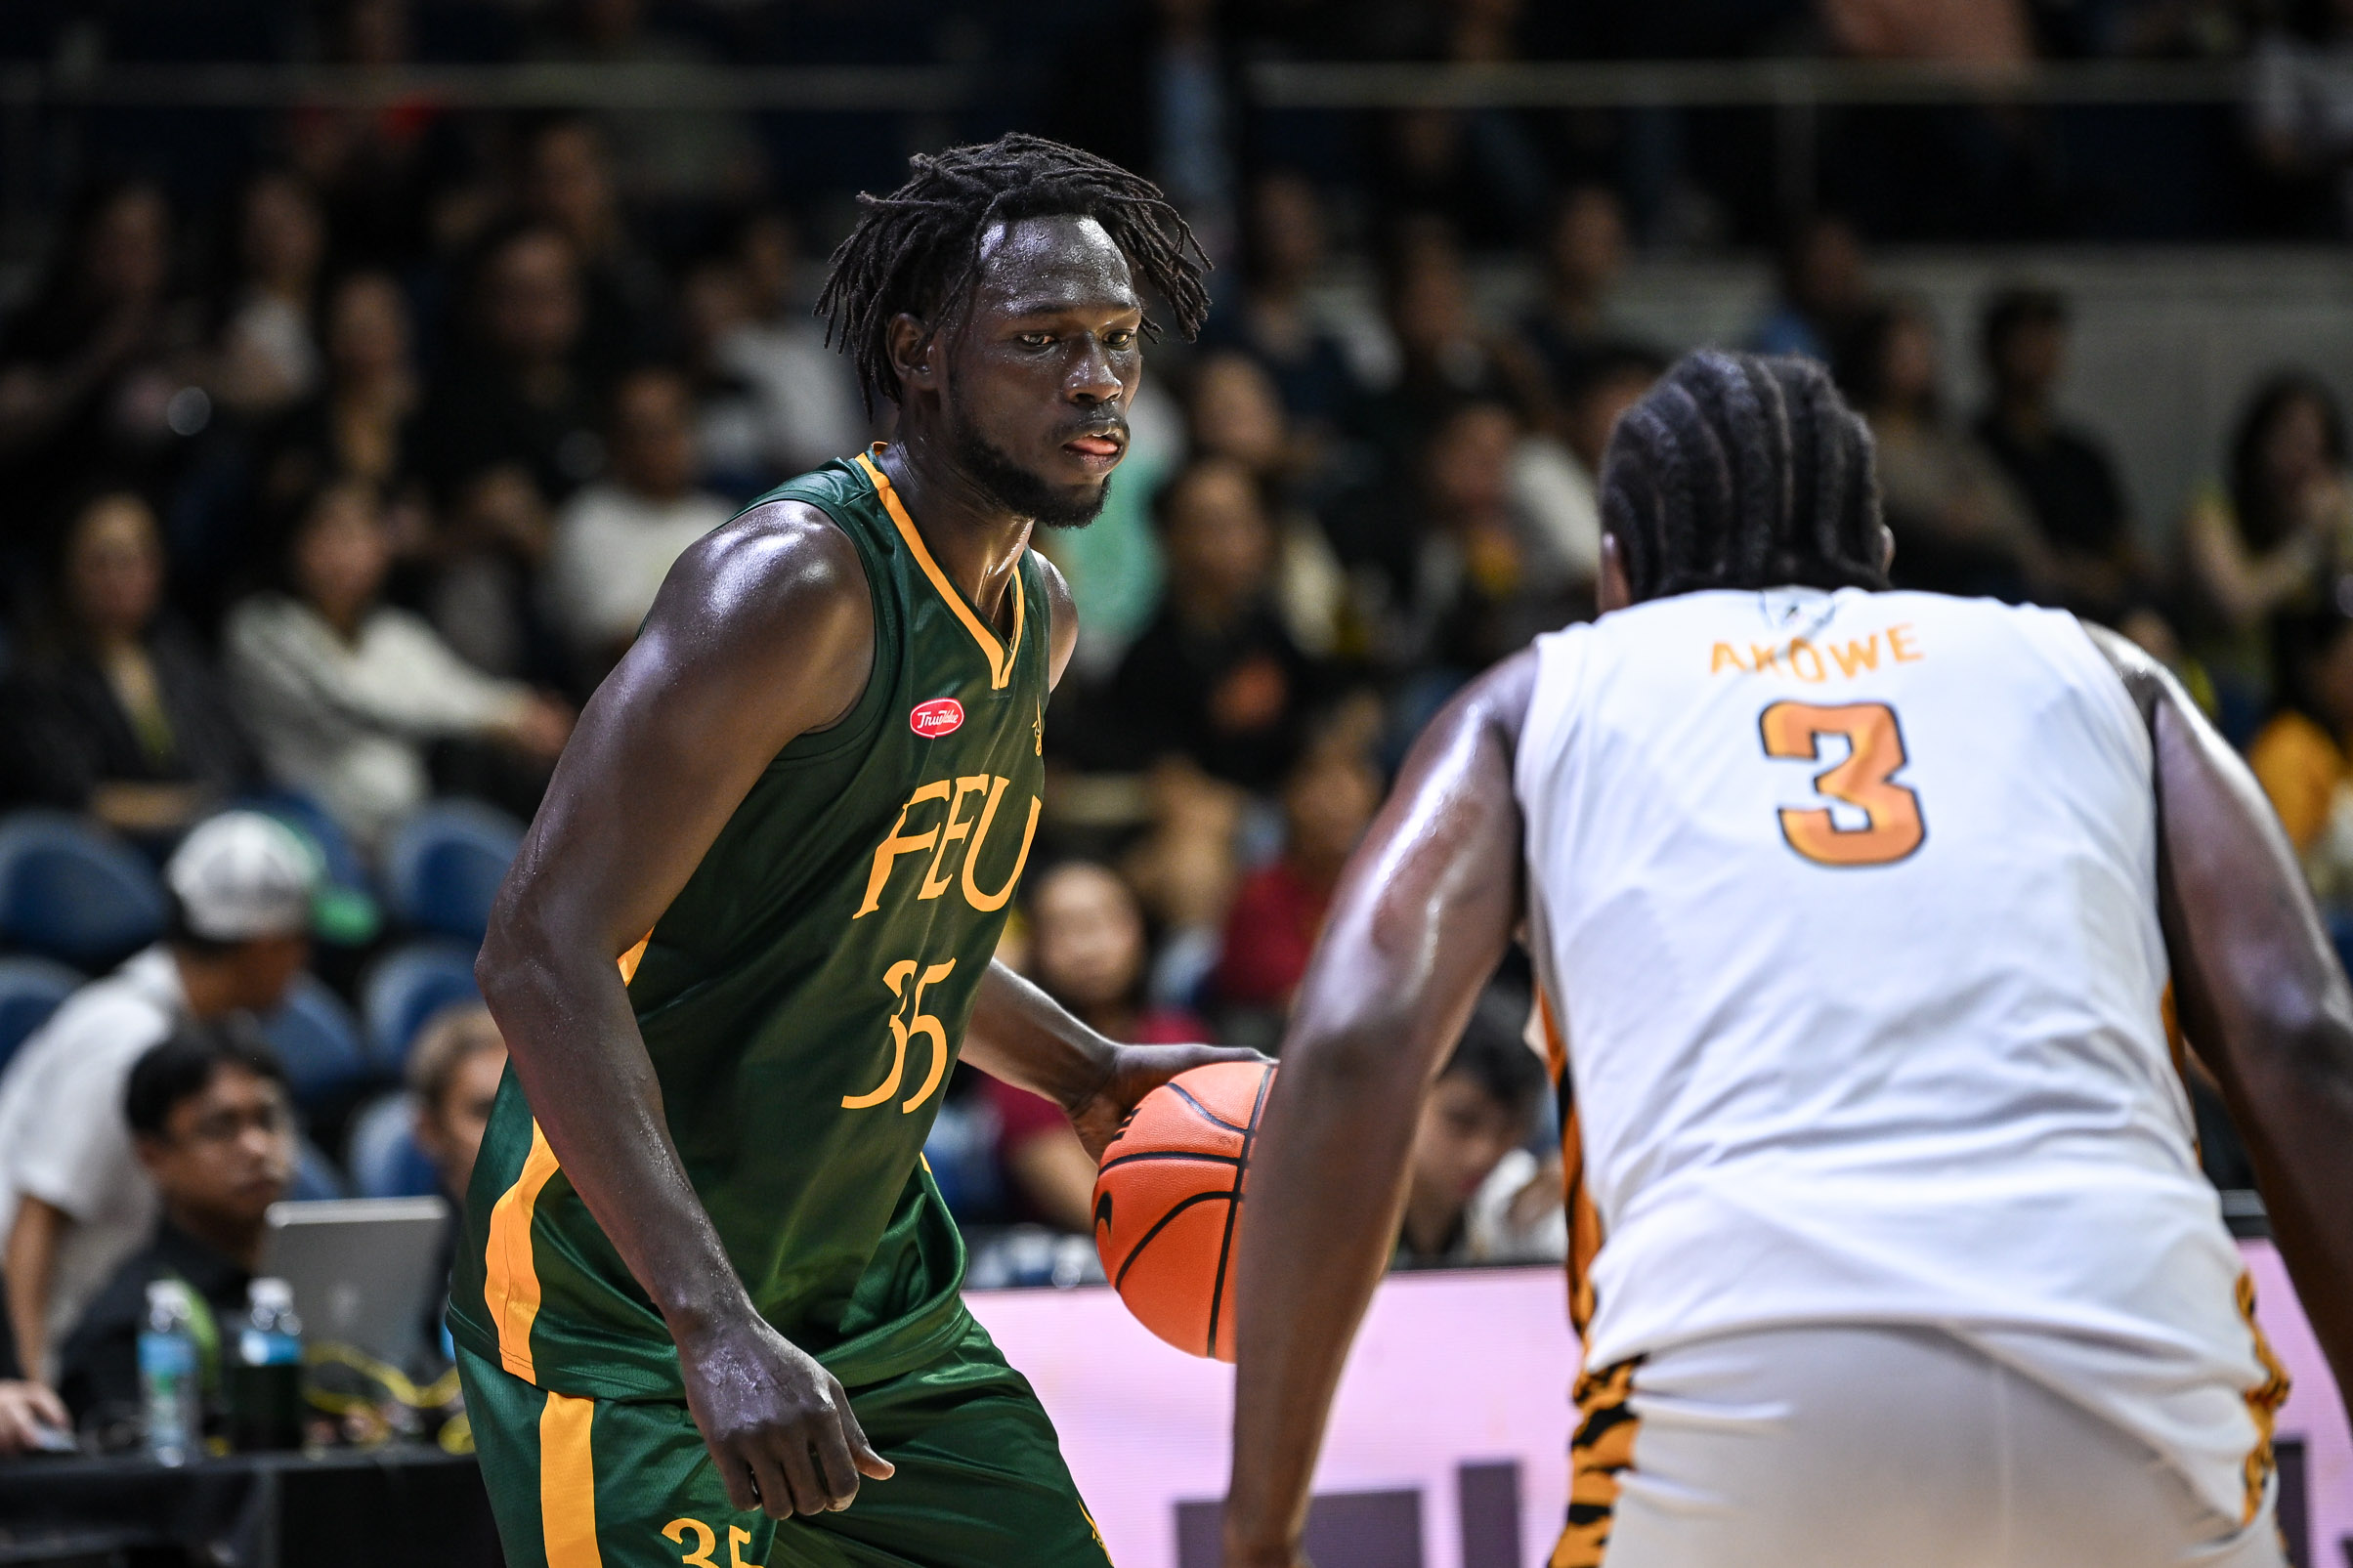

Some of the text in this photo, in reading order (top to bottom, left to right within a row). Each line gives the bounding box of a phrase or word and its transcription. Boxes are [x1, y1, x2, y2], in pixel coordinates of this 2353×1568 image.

[1710, 623, 1924, 684] AKOWE
[852, 773, 1042, 919] FEU
[1759, 699, 1925, 866] 3
[841, 957, 957, 1114] 35
